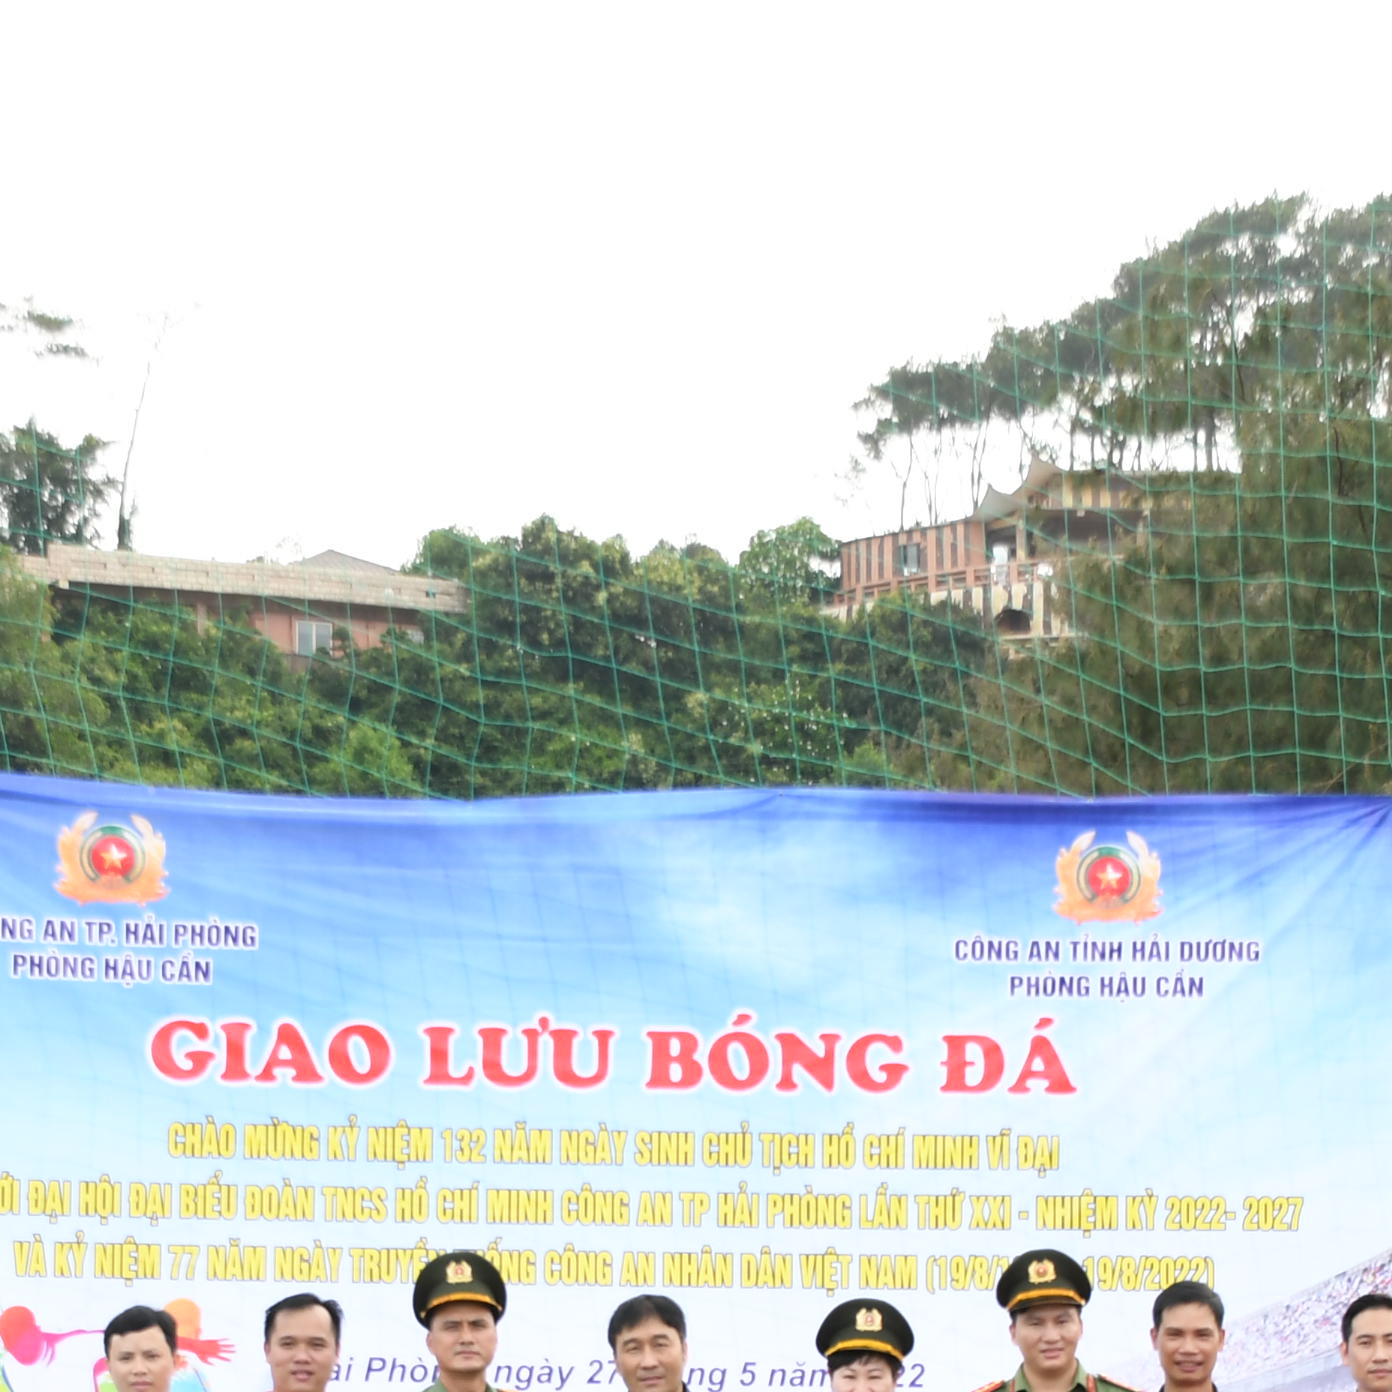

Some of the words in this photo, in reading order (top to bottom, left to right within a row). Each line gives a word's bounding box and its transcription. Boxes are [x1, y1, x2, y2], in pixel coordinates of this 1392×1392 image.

[43, 919, 76, 942] AN
[85, 921, 117, 944] TP.
[125, 914, 165, 945] HẢI
[174, 918, 256, 948] PHÒNG
[954, 935, 1019, 962] CÔNG
[1027, 940, 1061, 962] AN
[1070, 933, 1123, 962] TỈNH
[1132, 932, 1171, 962] HẢI
[1179, 938, 1260, 962] DƯƠNG
[12, 950, 95, 979] PHÒNG
[104, 953, 153, 986] HẬU
[1010, 970, 1090, 998] PHÒNG
[1100, 971, 1147, 1003] HẬU
[150, 1019, 392, 1085] GIAO
[422, 1015, 616, 1089] LƯU
[644, 1013, 909, 1093] BÓNG
[939, 1016, 1078, 1094] ĐÁ
[168, 1115, 237, 1158] CHÀO
[244, 1116, 321, 1160] MỪNG
[327, 1114, 360, 1162] KỶ
[367, 1119, 434, 1170] NIỆM
[441, 1127, 486, 1163] 132
[493, 1121, 553, 1164] NĂM
[560, 1122, 628, 1165] NGÀY
[634, 1130, 695, 1166] SINH
[702, 1120, 753, 1168] CHỦ
[759, 1132, 816, 1176] TỊCH
[821, 1121, 856, 1169] HỒ
[863, 1126, 906, 1169] CHÍ
[912, 1134, 980, 1170] MINH
[985, 1128, 1012, 1170] VĨ
[1016, 1134, 1060, 1178] ĐẠI
[27, 1179, 72, 1224] ĐẠI
[79, 1174, 122, 1226] HỘI
[128, 1182, 172, 1227] ĐẠI
[179, 1169, 238, 1220] BIỂU
[244, 1177, 315, 1221] ĐOÀN
[322, 1186, 387, 1222] TNCS
[394, 1176, 430, 1223] HỒ
[436, 1180, 480, 1224] CHÍ
[486, 1188, 554, 1225] MINH
[561, 1182, 630, 1226] CÔNG
[636, 1191, 673, 1227] AN
[679, 1191, 710, 1228] TP
[717, 1181, 759, 1228] HẢI
[766, 1185, 852, 1229] PHÒNG
[914, 1187, 966, 1230] THỨ
[968, 1194, 1012, 1230] XXI
[1018, 1210, 1029, 1220] -
[1036, 1188, 1118, 1239] NHIỆM
[1125, 1188, 1158, 1231] KỲ
[1242, 1195, 1304, 1231] 2027
[13, 1234, 47, 1277] VÀ
[54, 1231, 88, 1278] KỶ
[94, 1236, 161, 1287] NIỆM
[168, 1244, 200, 1280] 77
[207, 1238, 267, 1282] NĂM
[274, 1239, 343, 1283] NGÀY
[349, 1237, 446, 1284] TRUYỀ
[453, 1237, 537, 1285] ỐNG
[544, 1243, 613, 1286] CÔNG
[619, 1252, 656, 1288] AN
[662, 1245, 733, 1289] NHÂN
[740, 1246, 793, 1289] DÂN
[799, 1246, 853, 1297] VIỆT
[860, 1254, 918, 1290] NAM
[494, 1358, 575, 1391] ngày
[587, 1359, 617, 1384] 27
[740, 1362, 757, 1386] 5
